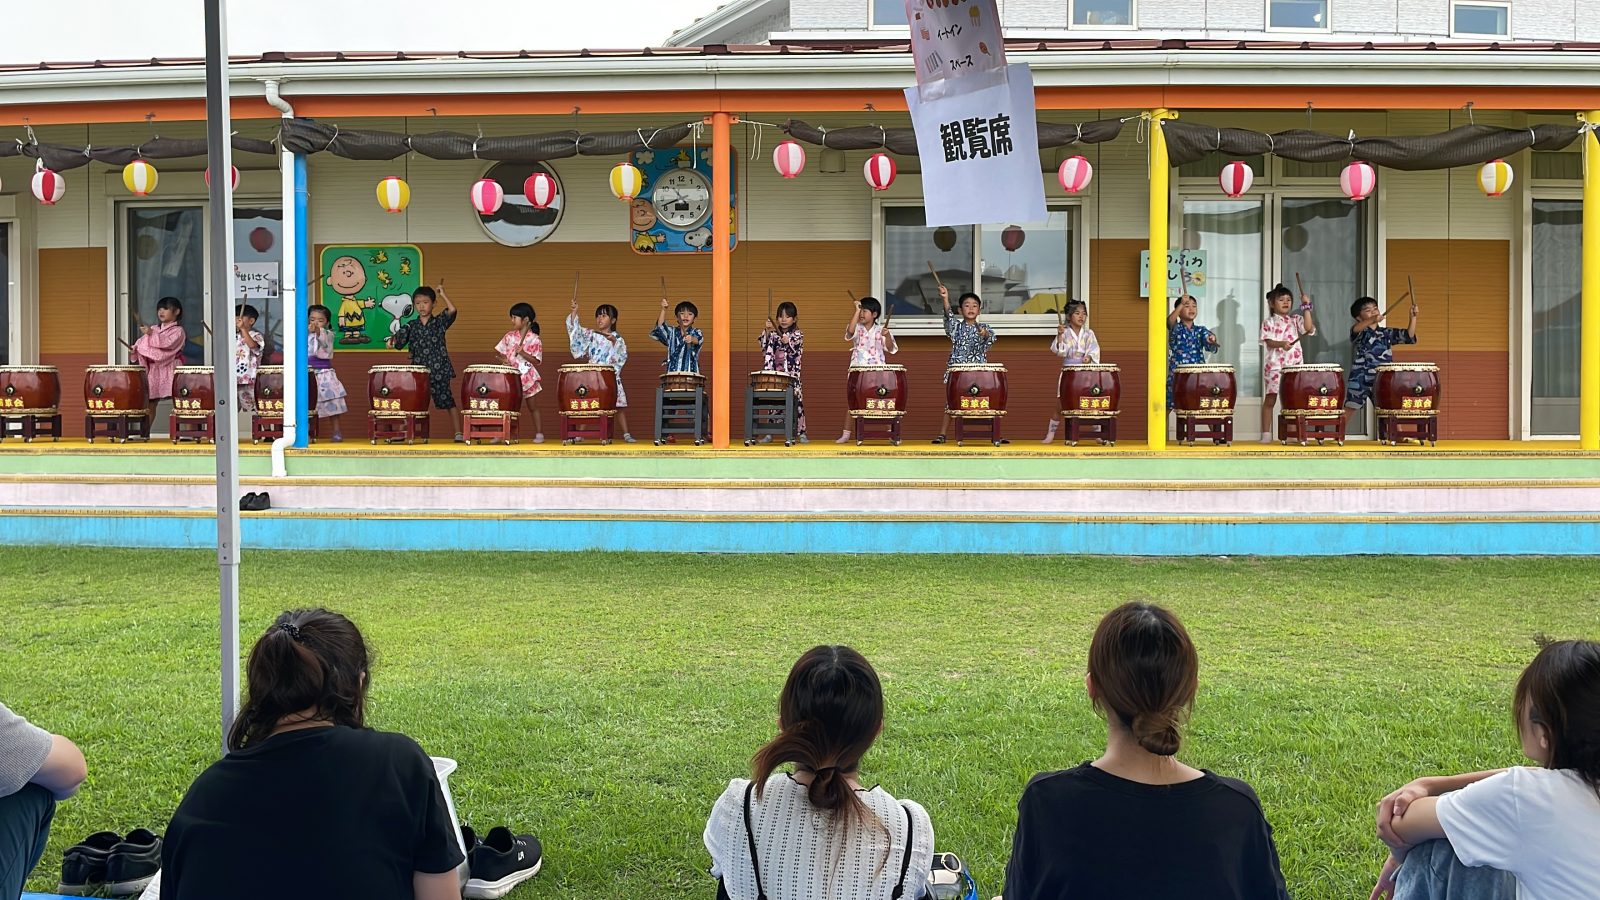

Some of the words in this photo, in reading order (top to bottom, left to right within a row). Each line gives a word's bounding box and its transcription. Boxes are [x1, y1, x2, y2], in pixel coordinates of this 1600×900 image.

[937, 23, 962, 40] イートイン
[950, 54, 973, 70] スペース
[940, 113, 1013, 163] 観覧席
[240, 273, 269, 281] せいさく
[240, 284, 269, 293] コーナー
[87, 399, 115, 409] 若草会
[373, 399, 400, 410] 若草会
[470, 399, 499, 410] 若草会
[570, 399, 600, 410] 若草会
[866, 399, 896, 409] 若草会
[960, 399, 990, 409] 若草会
[1080, 398, 1111, 409] 若草会
[1200, 398, 1230, 409] 若草会
[1308, 397, 1339, 408] 若草会
[1402, 398, 1432, 409] 若草会
